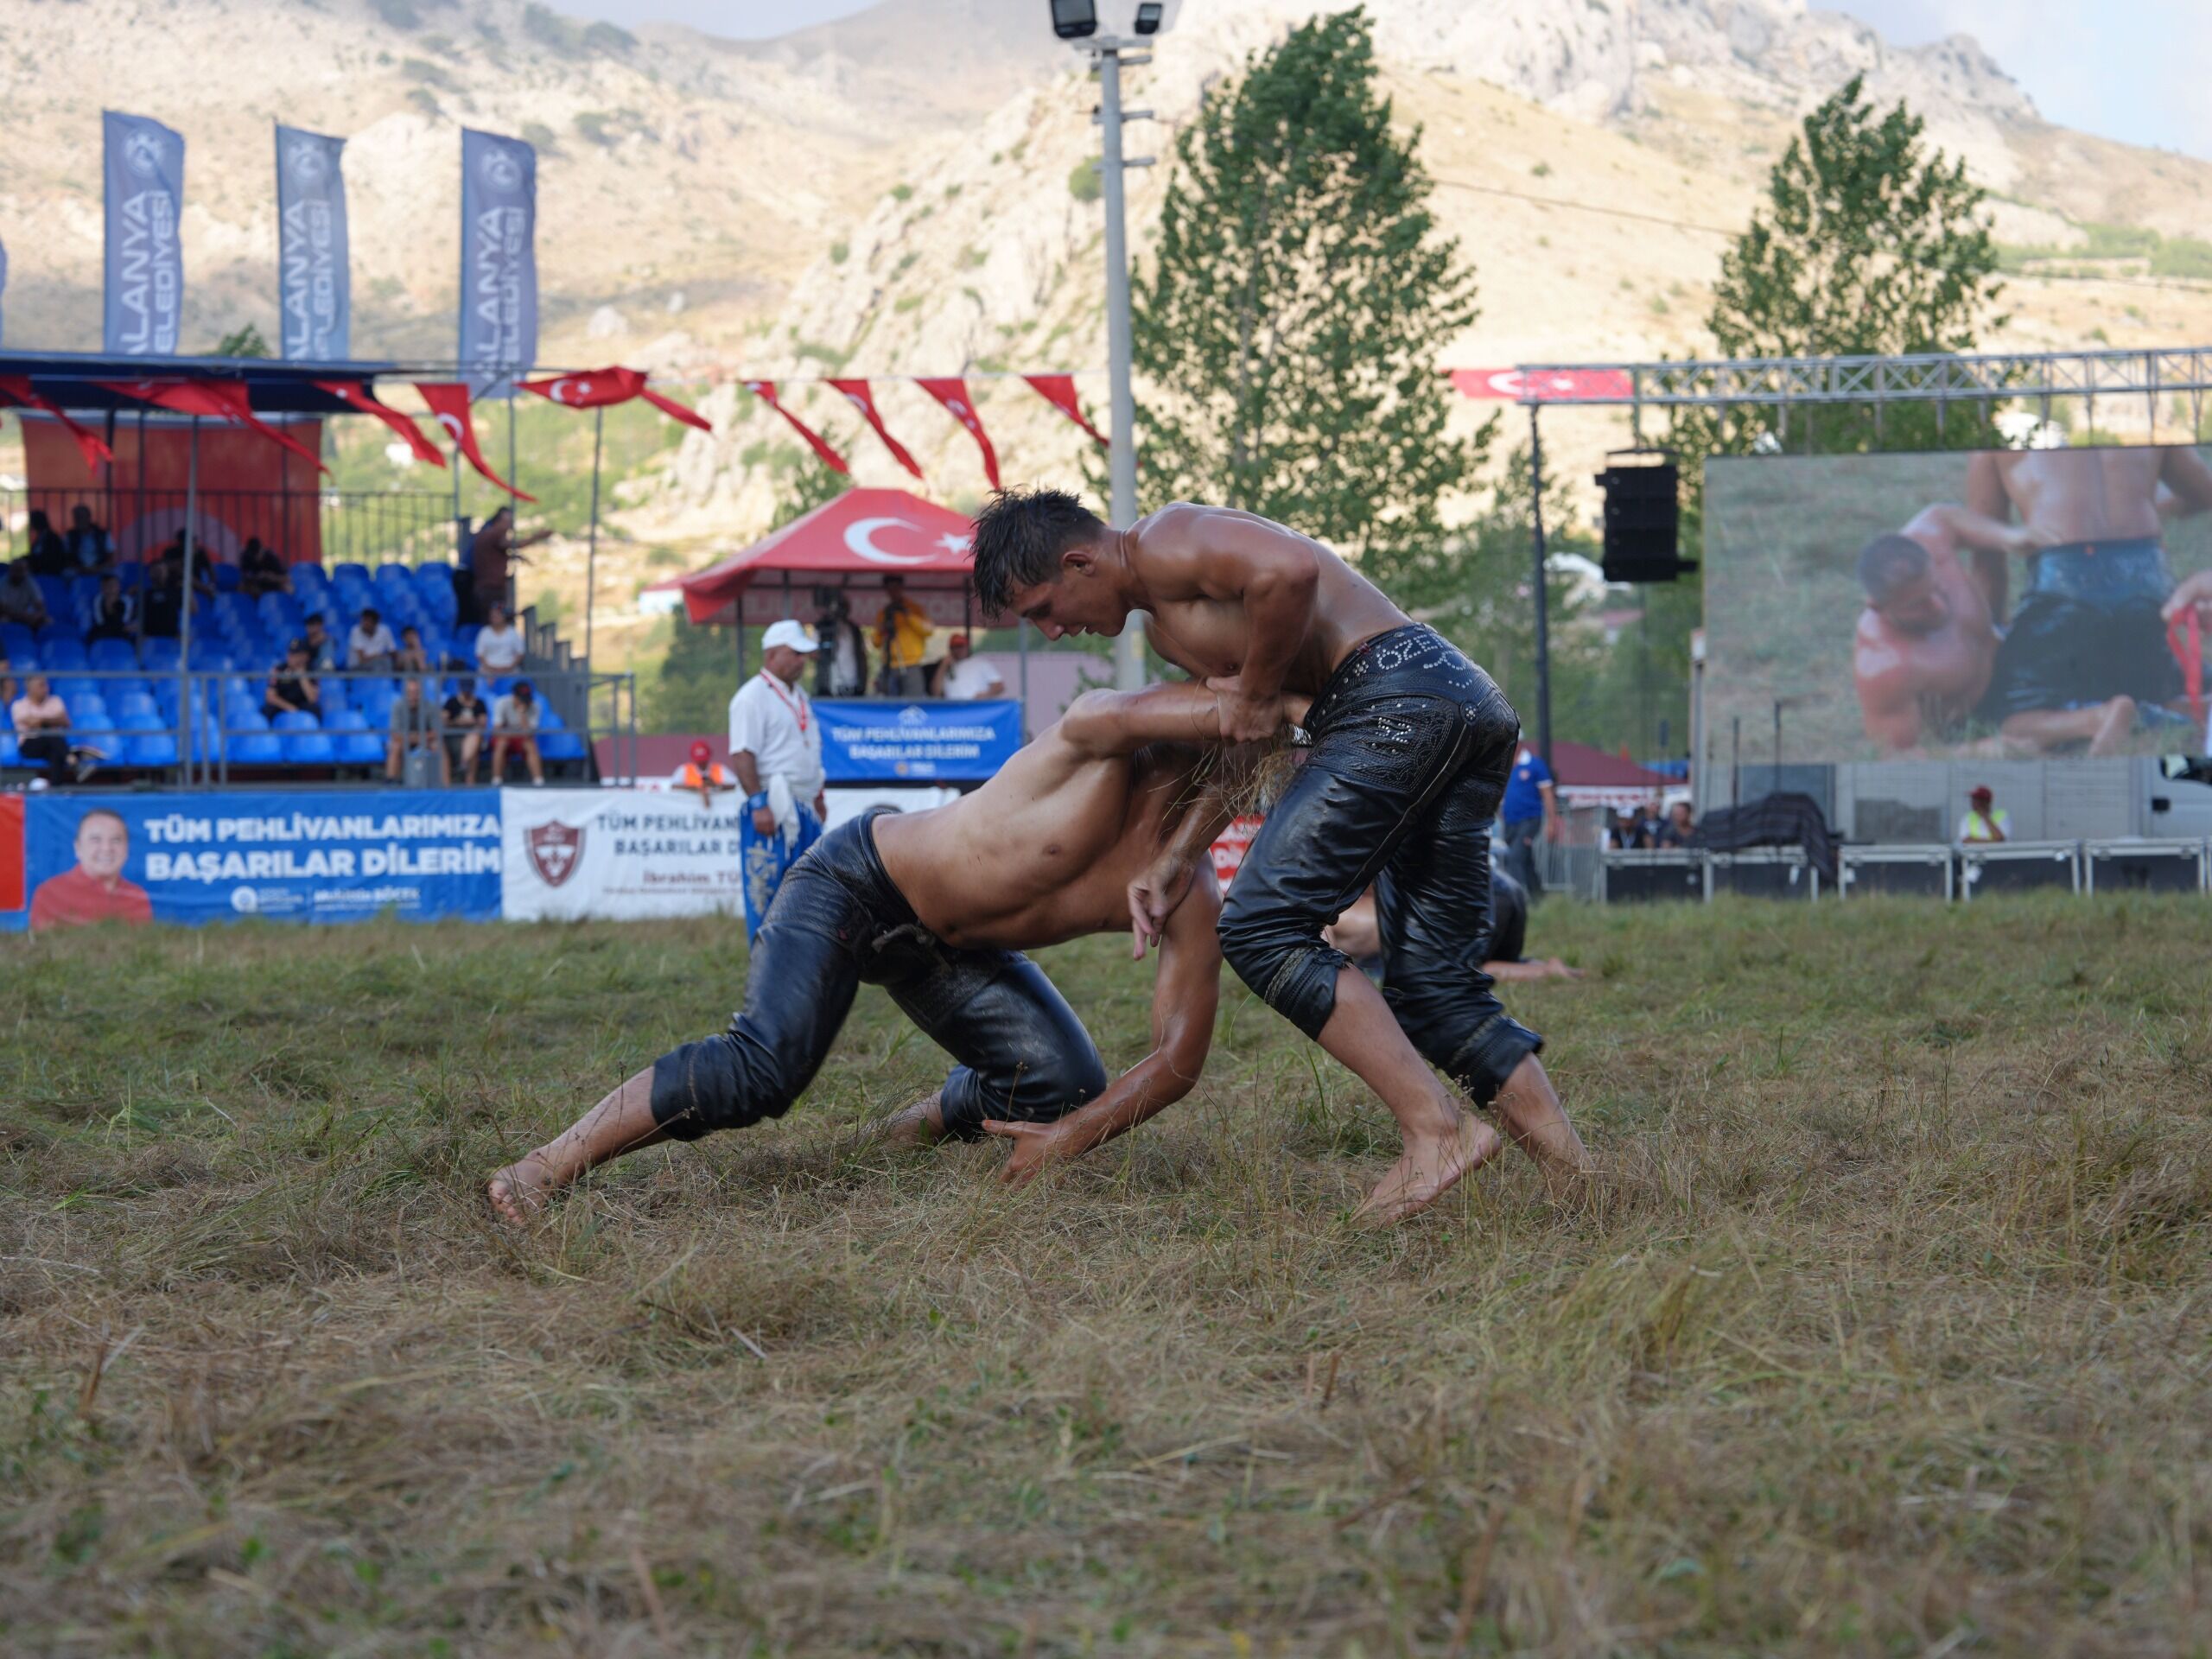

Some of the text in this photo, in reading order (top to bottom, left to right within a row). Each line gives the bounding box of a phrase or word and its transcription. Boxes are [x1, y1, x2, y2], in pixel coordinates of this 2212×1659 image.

[148, 188, 176, 354] ELEDİYESİ
[831, 725, 862, 741] TÜM
[144, 811, 500, 843] TÜM PEHLİVANLARIMIZA
[598, 810, 638, 832] TÜM
[614, 838, 721, 857] BAŞARILAR
[146, 841, 500, 885] BAŞARILAR DİLERİM
